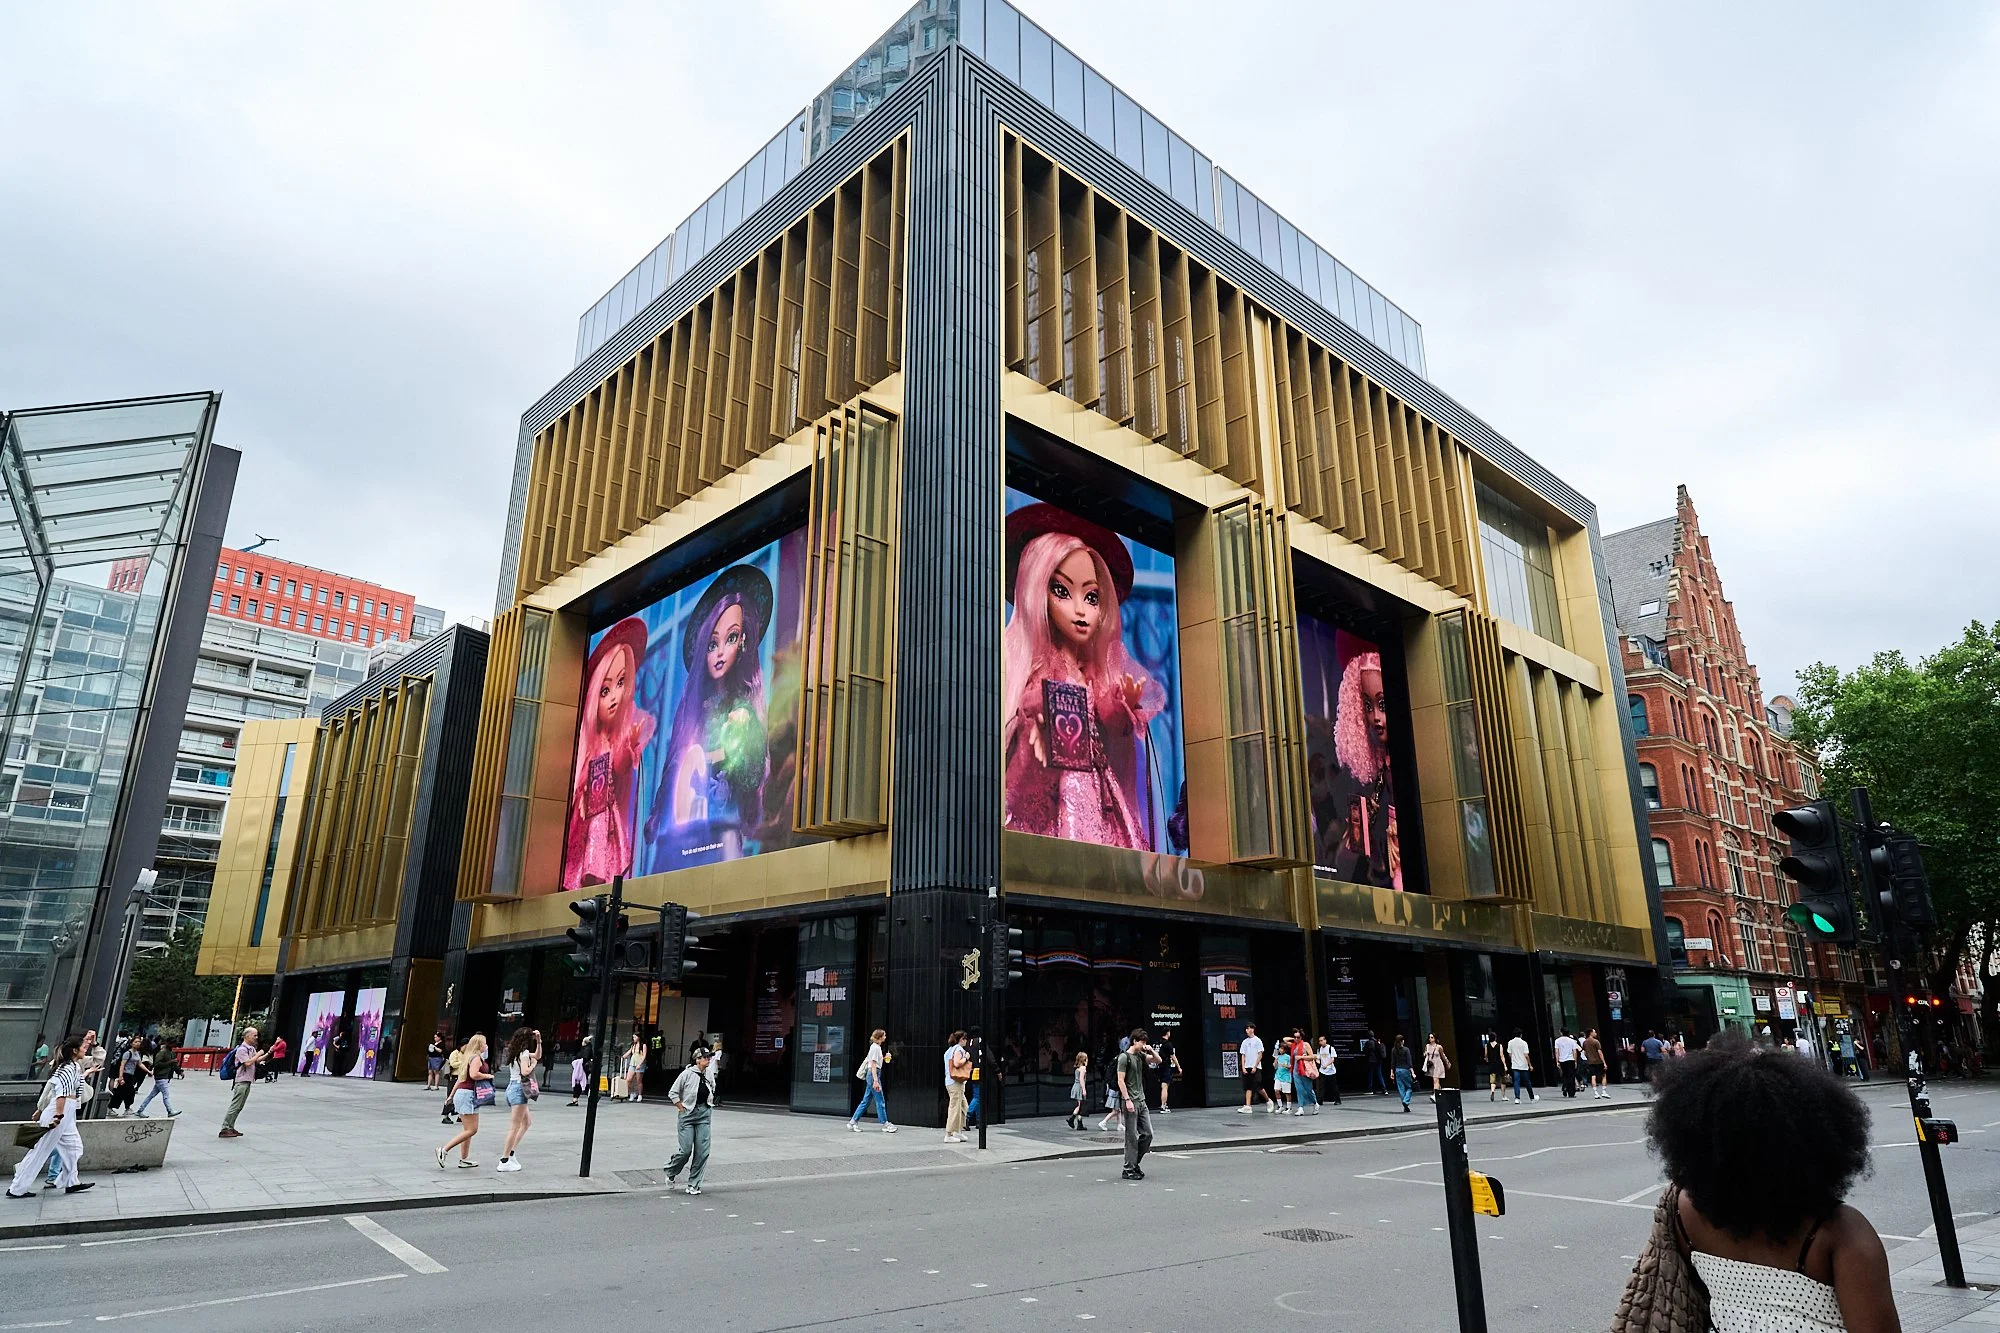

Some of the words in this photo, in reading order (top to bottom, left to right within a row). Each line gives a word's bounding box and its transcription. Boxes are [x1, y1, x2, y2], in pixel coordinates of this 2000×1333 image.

[1055, 692, 1080, 706] LOVE
[1149, 961, 1180, 969] OUTERNET
[1226, 979, 1238, 992] LIVE
[810, 988, 829, 1001] PRIDE
[829, 987, 847, 1001] WIDE
[1213, 992, 1231, 1005] PRIDE
[1231, 993, 1247, 1006] WIDE
[816, 1002, 833, 1017] OPEN
[1220, 1006, 1236, 1019] OPEN
